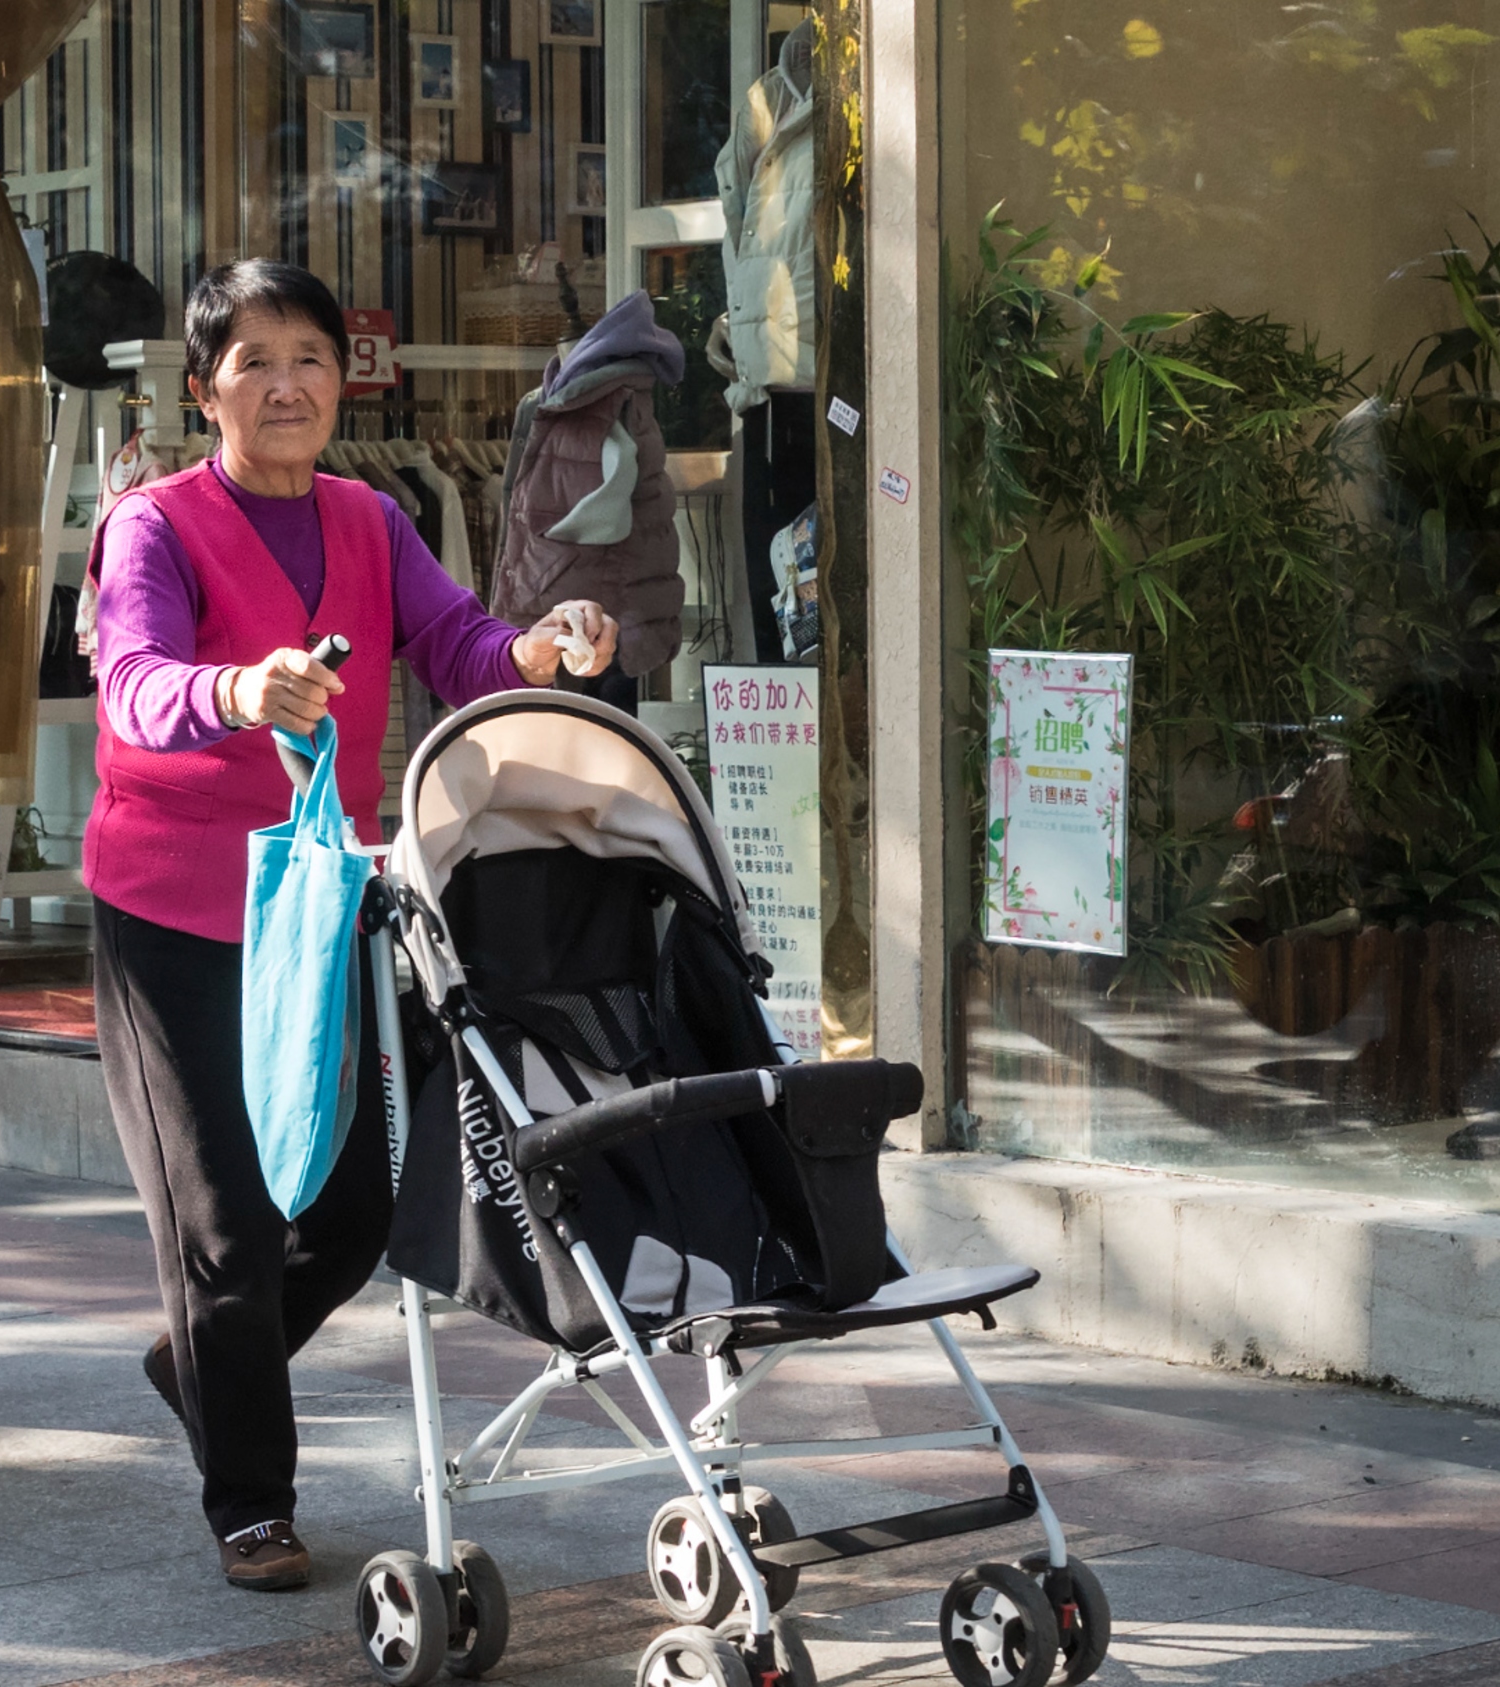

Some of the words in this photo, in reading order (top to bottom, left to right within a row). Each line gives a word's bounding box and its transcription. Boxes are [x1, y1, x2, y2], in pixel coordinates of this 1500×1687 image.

[346, 337, 377, 377] 9
[712, 678, 813, 711] 你的加入
[714, 721, 817, 746] 为我们带来更
[1034, 718, 1084, 755] 招聘
[1029, 784, 1088, 807] 销售精英
